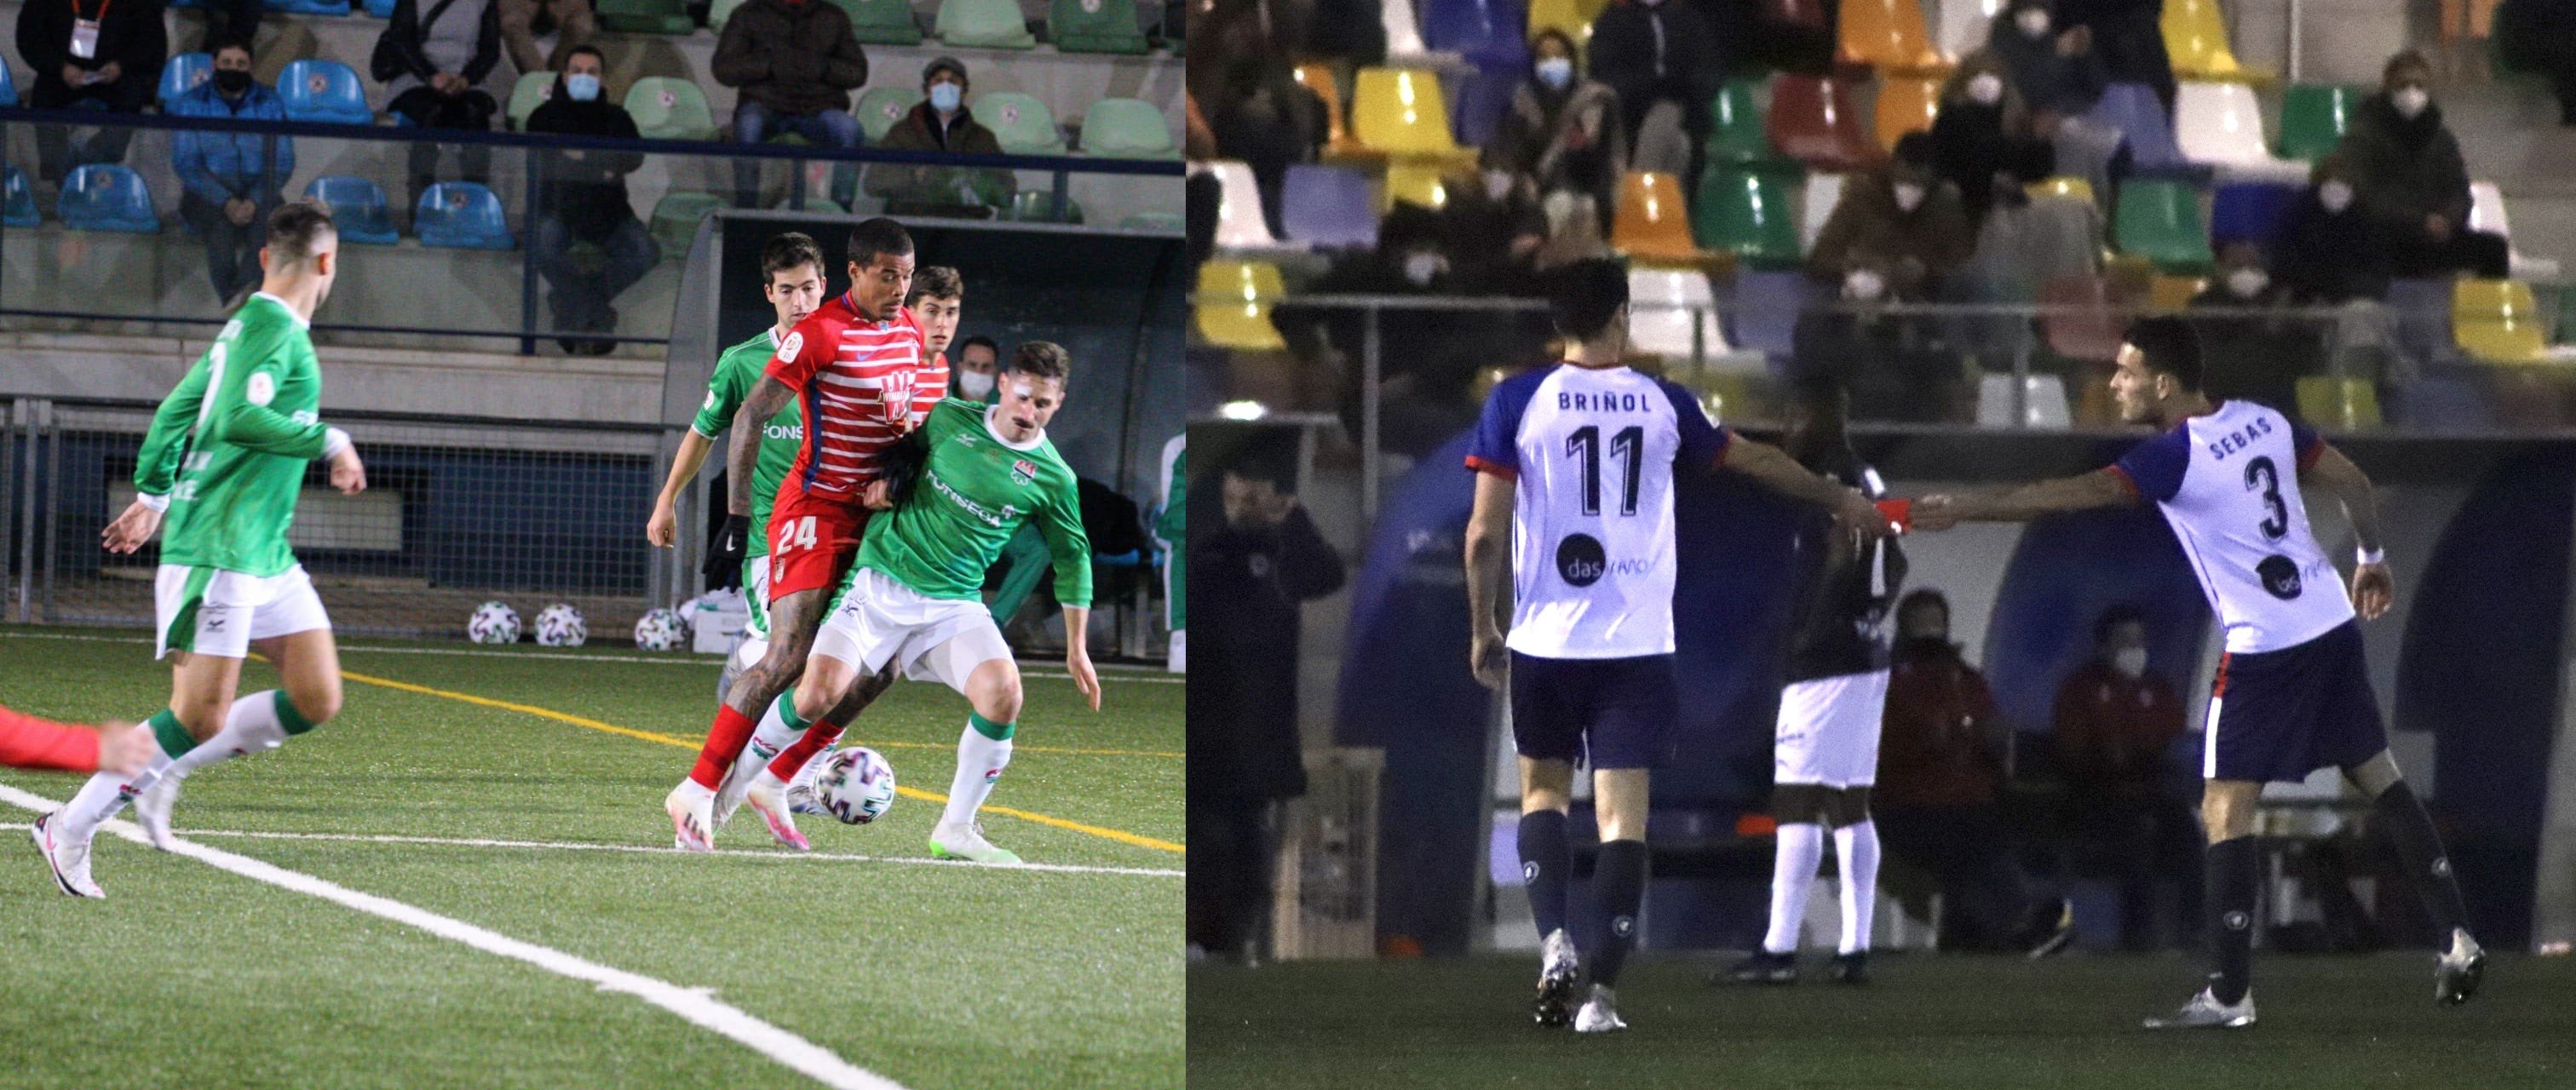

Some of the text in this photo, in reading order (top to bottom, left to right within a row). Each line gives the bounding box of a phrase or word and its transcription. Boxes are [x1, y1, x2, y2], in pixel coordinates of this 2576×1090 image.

[1558, 391, 1652, 413] BRIÑOL
[2209, 416, 2272, 460] SEBAS
[1566, 425, 1644, 517] 11
[2244, 455, 2289, 542] 3
[776, 515, 818, 555] 24
